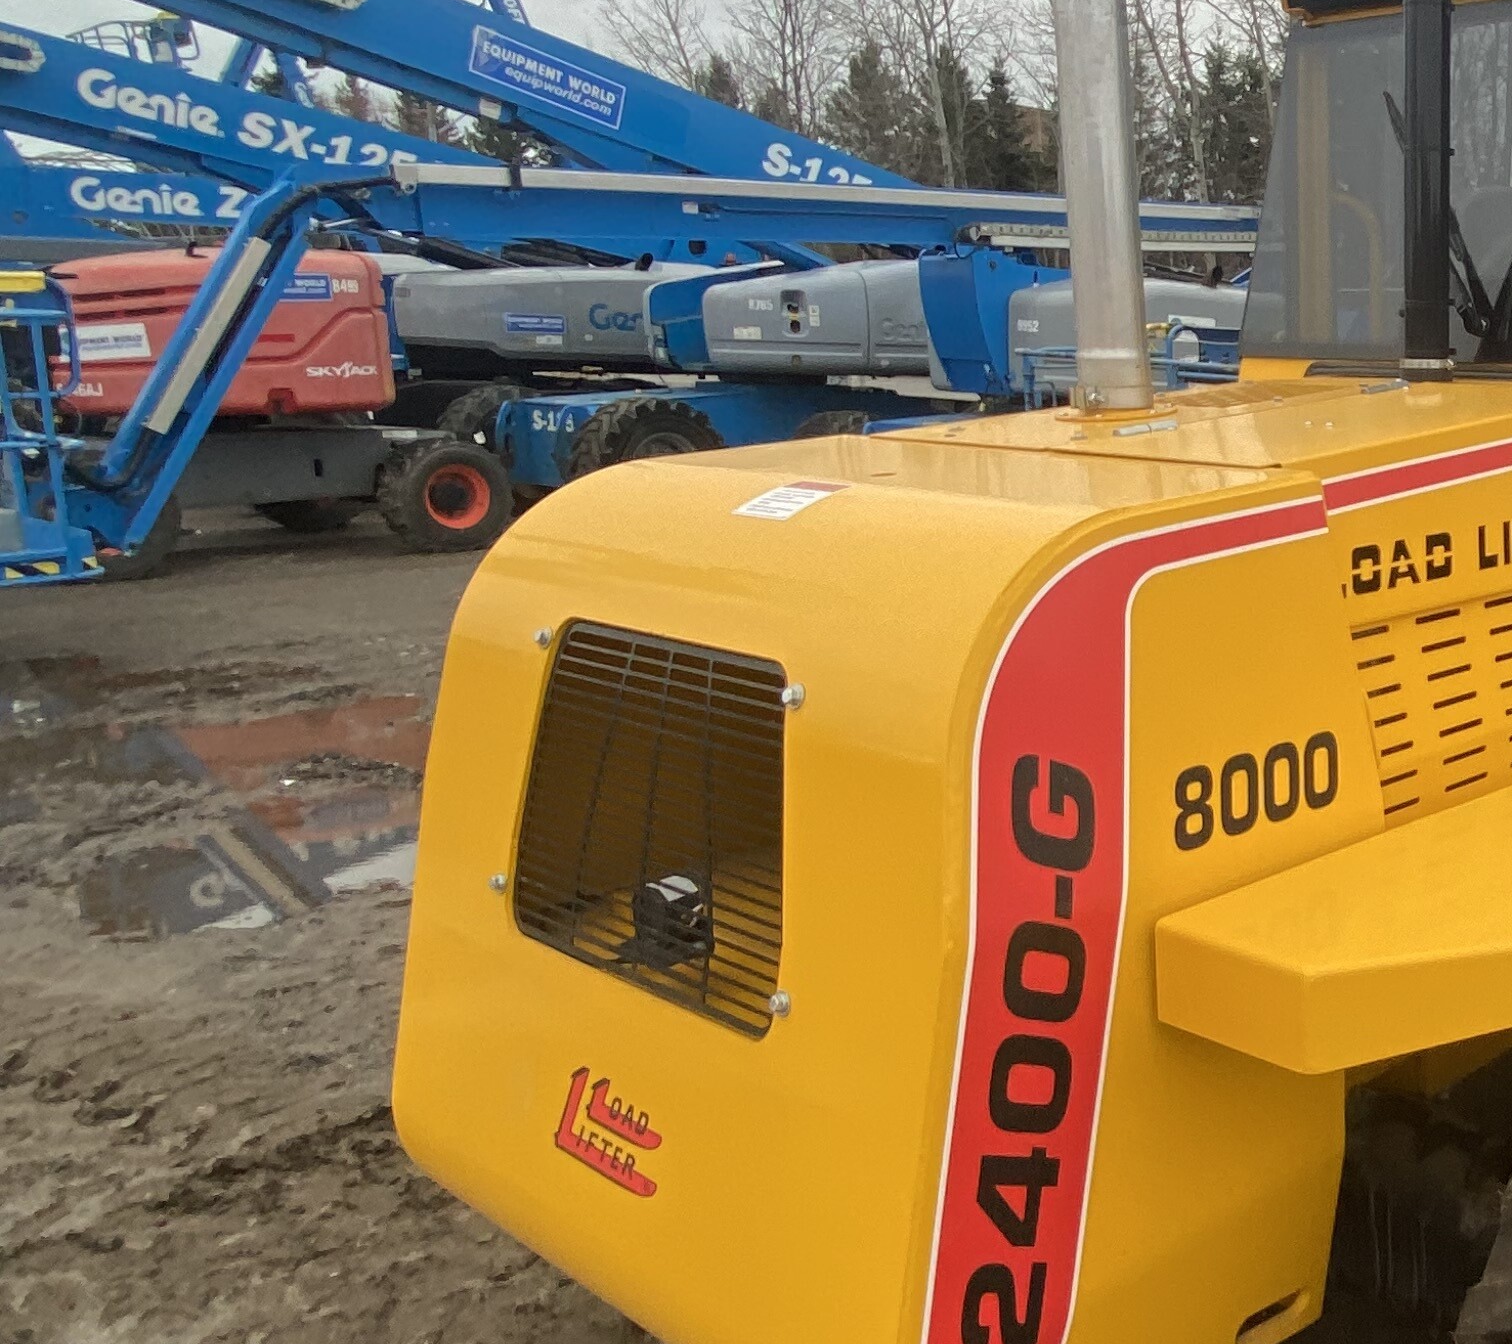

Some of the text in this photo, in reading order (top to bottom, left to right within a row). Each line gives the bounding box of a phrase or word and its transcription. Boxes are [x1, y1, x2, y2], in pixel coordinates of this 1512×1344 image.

[77, 67, 225, 138] Genie
[482, 41, 617, 106] EQUIPMENT WORLD
[504, 66, 613, 118] equipworld.com
[70, 176, 205, 217] Genie
[1173, 730, 1339, 852] 8000
